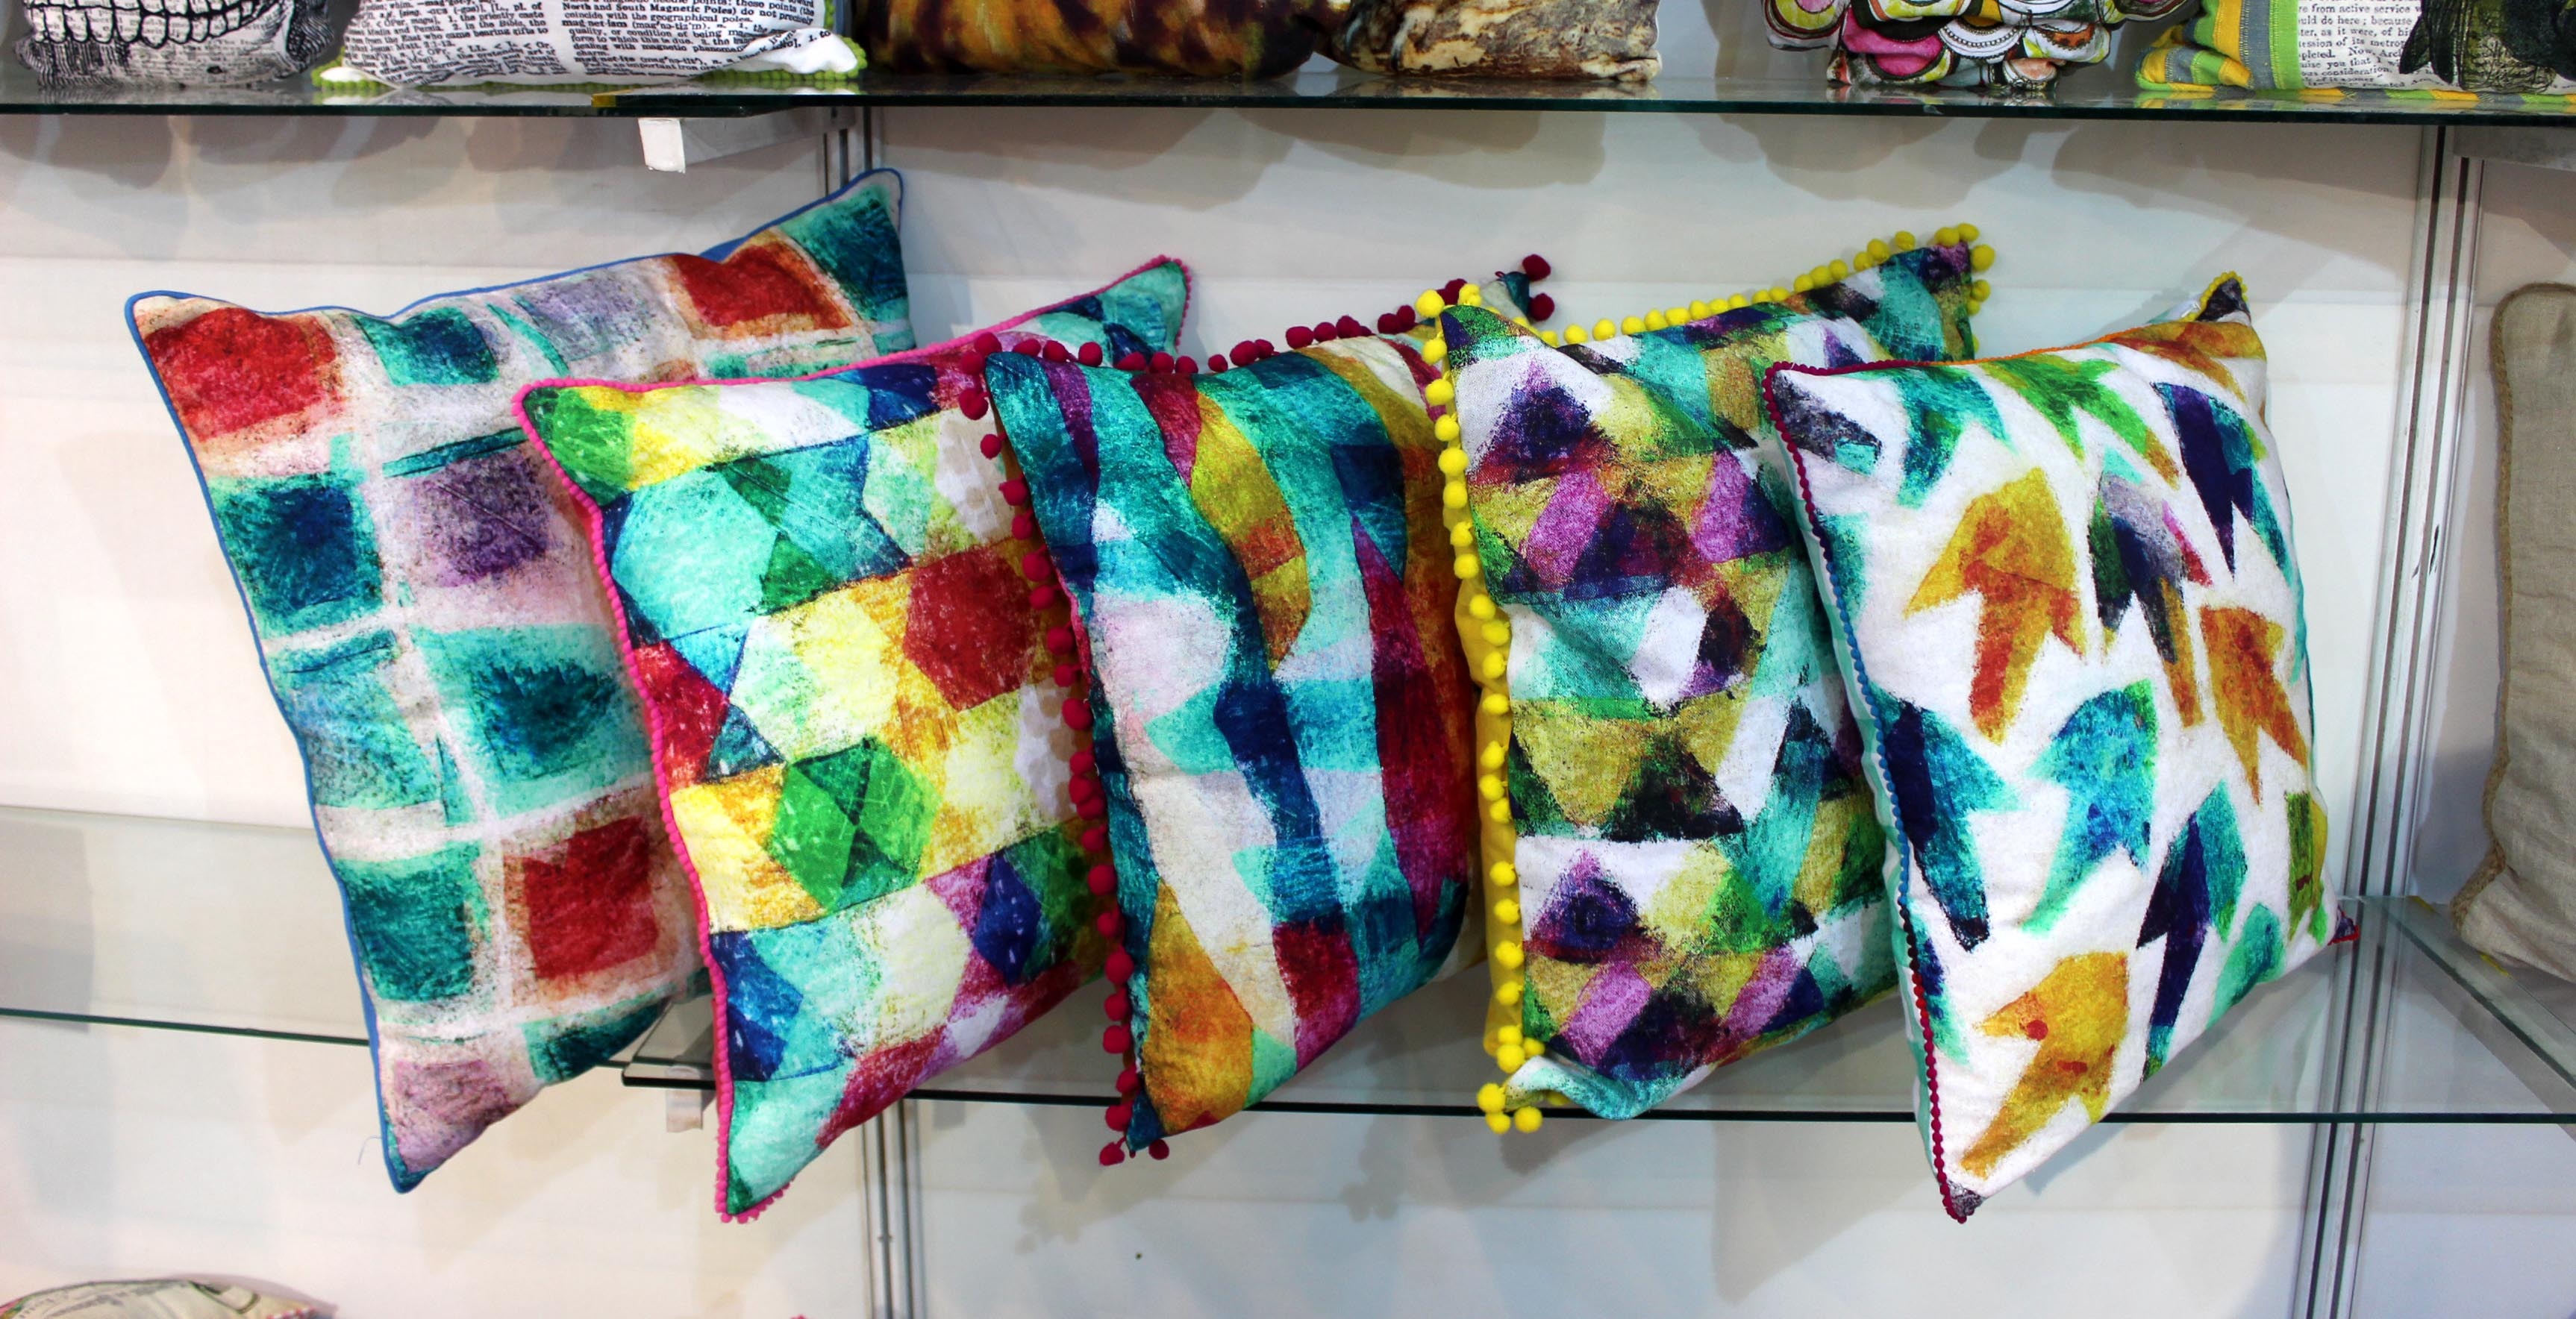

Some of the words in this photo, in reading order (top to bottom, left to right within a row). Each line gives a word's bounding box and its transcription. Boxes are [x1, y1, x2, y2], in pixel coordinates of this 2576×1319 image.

[650, 4, 700, 13] Magnetic
[704, 5, 737, 14] Poles)
[760, 10, 777, 18] not
[2312, 3, 2335, 13] from
[2339, 4, 2370, 13] active
[2375, 4, 2410, 13] service
[651, 14, 717, 22] geographical
[2299, 15, 2316, 25] uld
[2321, 15, 2333, 25] do
[2372, 15, 2412, 25] because
[393, 26, 410, 34] and
[529, 19, 546, 27] the
[2338, 27, 2346, 35] it
[2382, 27, 2392, 36] of
[2336, 36, 2348, 46] of
[2299, 49, 2336, 60] pleted.
[2327, 61, 2346, 69] you
